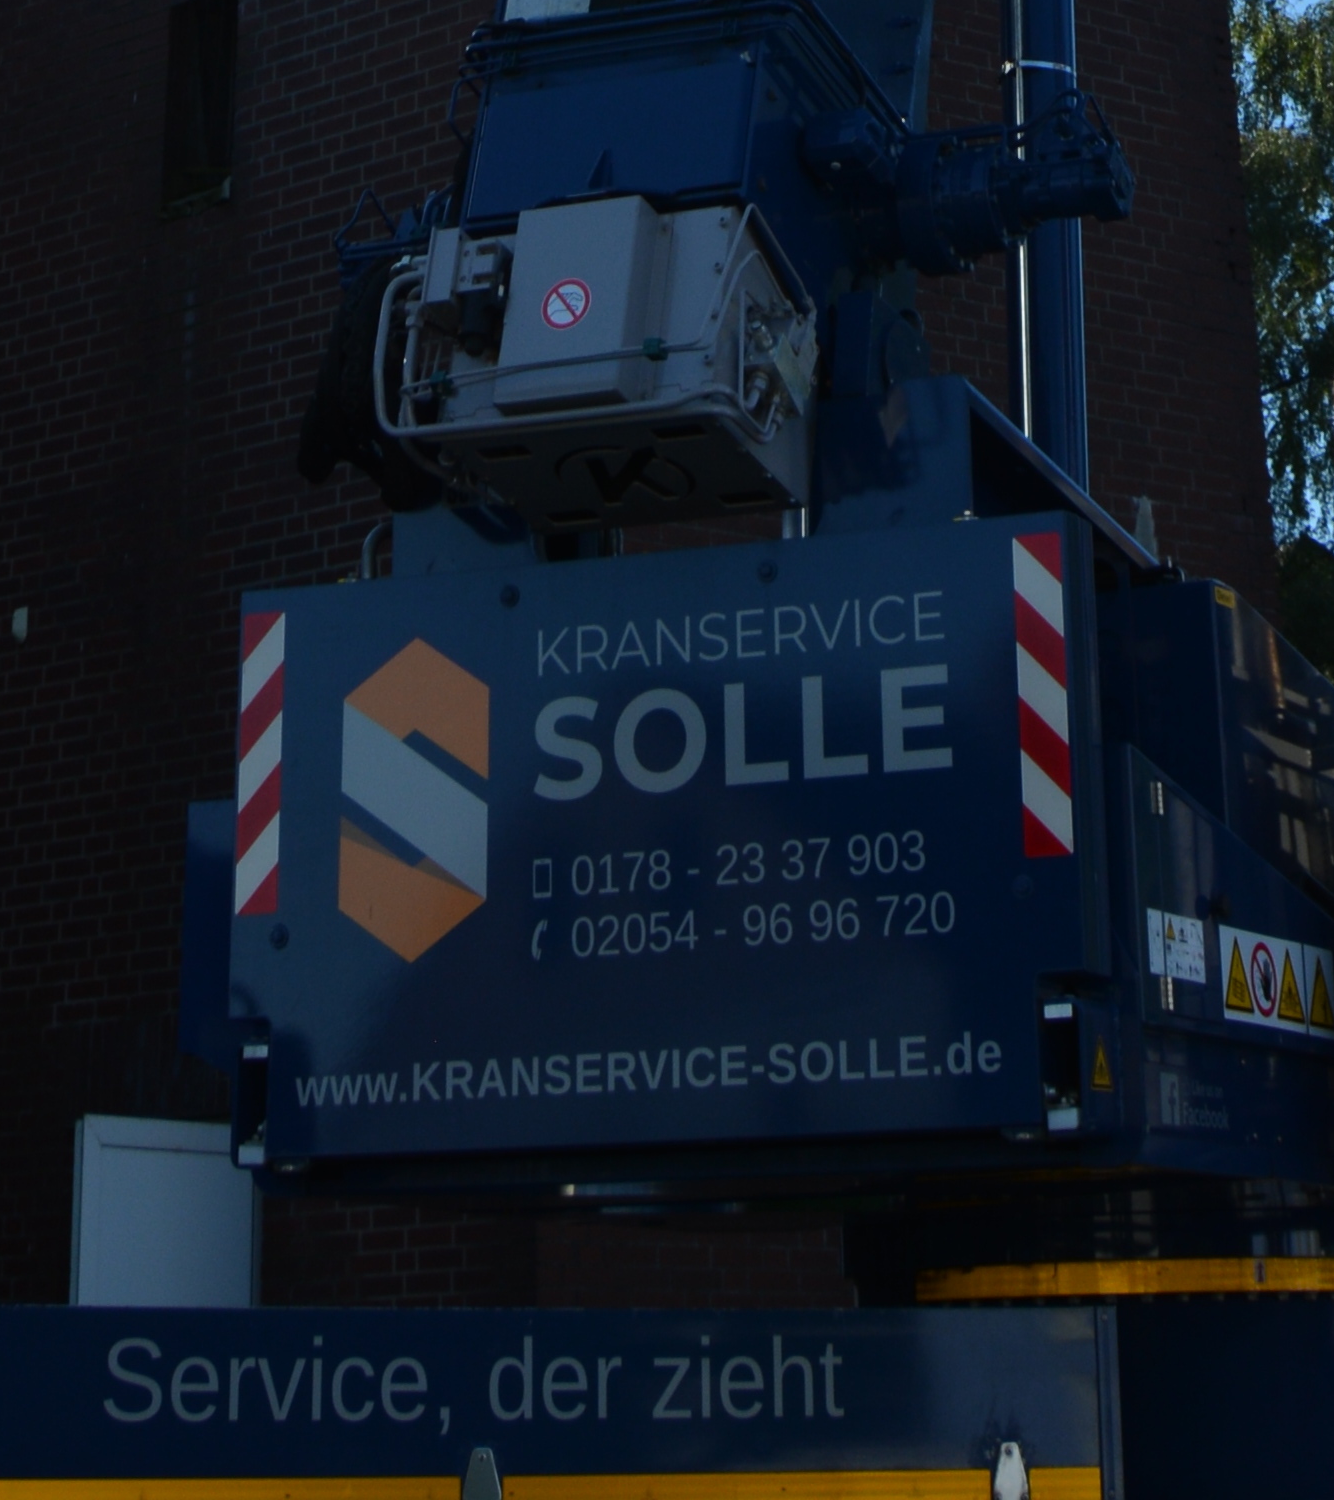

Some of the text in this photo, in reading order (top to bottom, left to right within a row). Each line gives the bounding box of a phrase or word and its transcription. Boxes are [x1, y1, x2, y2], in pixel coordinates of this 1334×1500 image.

[536, 590, 946, 678] KRANSERVICE
[533, 663, 954, 802] SOLLE
[571, 849, 671, 897] 0178
[716, 842, 766, 887] 23
[781, 837, 832, 882] 37
[847, 828, 926, 876] 903
[571, 909, 699, 959] 02054
[742, 902, 793, 948] 96
[809, 897, 860, 943] 96
[876, 891, 956, 939] 720
[295, 1032, 1002, 1109] www.KRANSERVICE-SOLLE.de
[1182, 1101, 1231, 1130] Facebook
[102, 1333, 846, 1437] Service, der zieht
